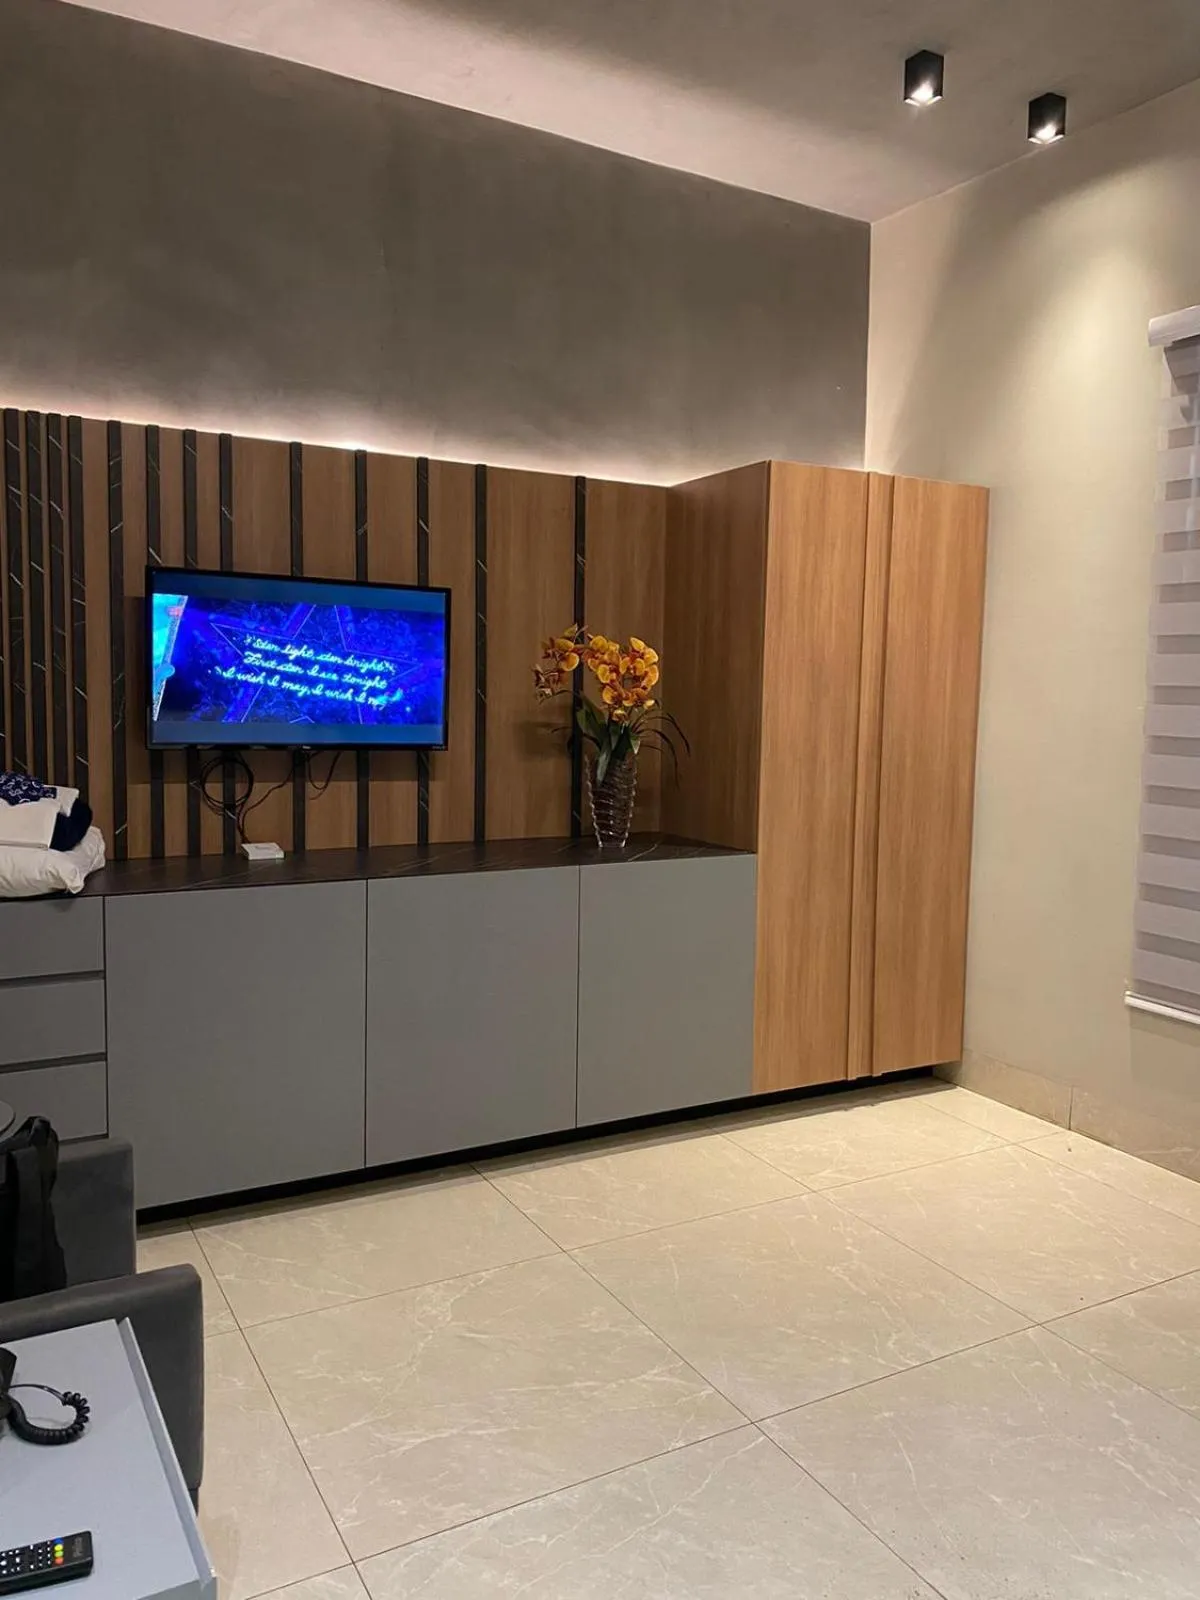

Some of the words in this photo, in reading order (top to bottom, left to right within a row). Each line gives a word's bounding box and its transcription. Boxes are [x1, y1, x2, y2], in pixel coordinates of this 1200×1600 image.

[223, 666, 236, 678] I
[236, 671, 266, 684] wish
[267, 674, 280, 687] I
[311, 683, 324, 695] I
[324, 688, 353, 701] wish
[354, 691, 367, 703] I
[243, 651, 277, 669] First
[307, 664, 319, 677] I
[319, 671, 339, 681] see
[342, 673, 388, 690] tonight
